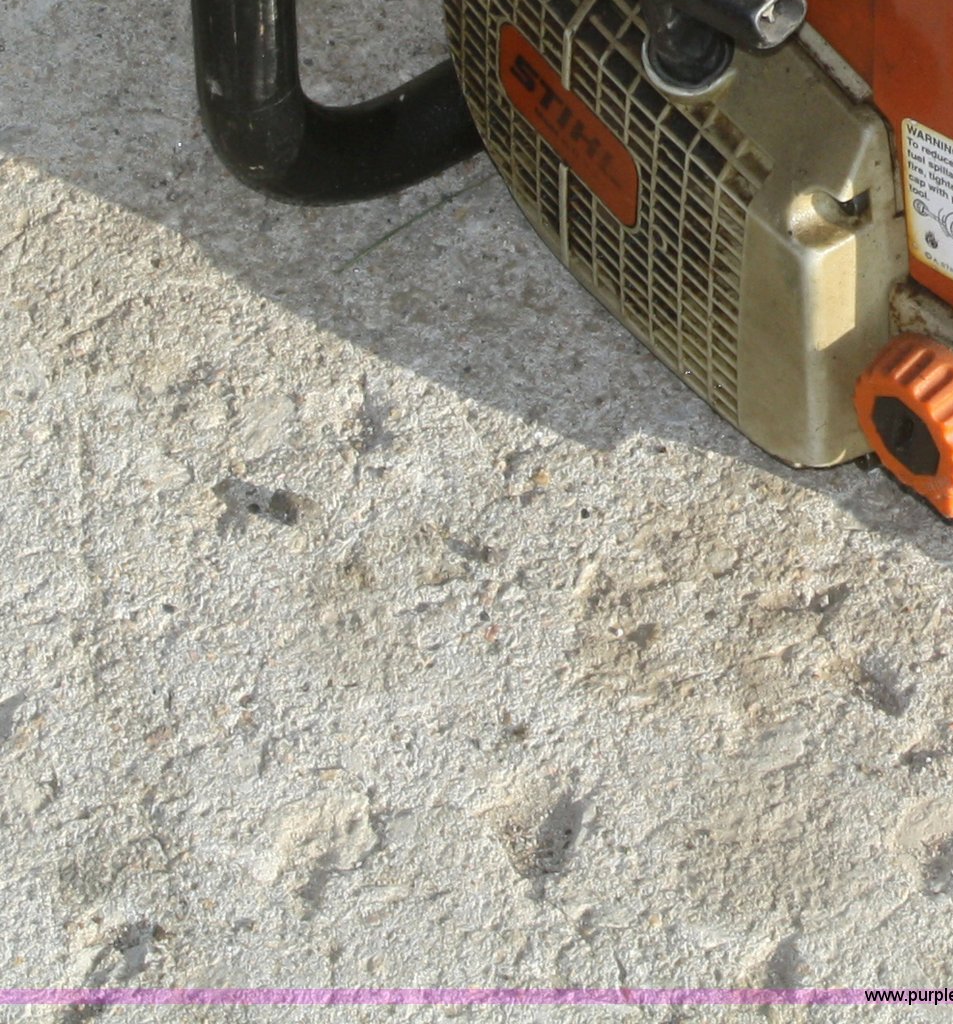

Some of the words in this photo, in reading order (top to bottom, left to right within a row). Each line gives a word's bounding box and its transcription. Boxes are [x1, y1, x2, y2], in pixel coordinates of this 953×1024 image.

[510, 54, 624, 190] STIHL
[907, 137, 919, 149] To
[907, 149, 925, 164] fuel
[907, 161, 927, 178] fire,
[908, 174, 926, 188] cap
[928, 183, 949, 199] with
